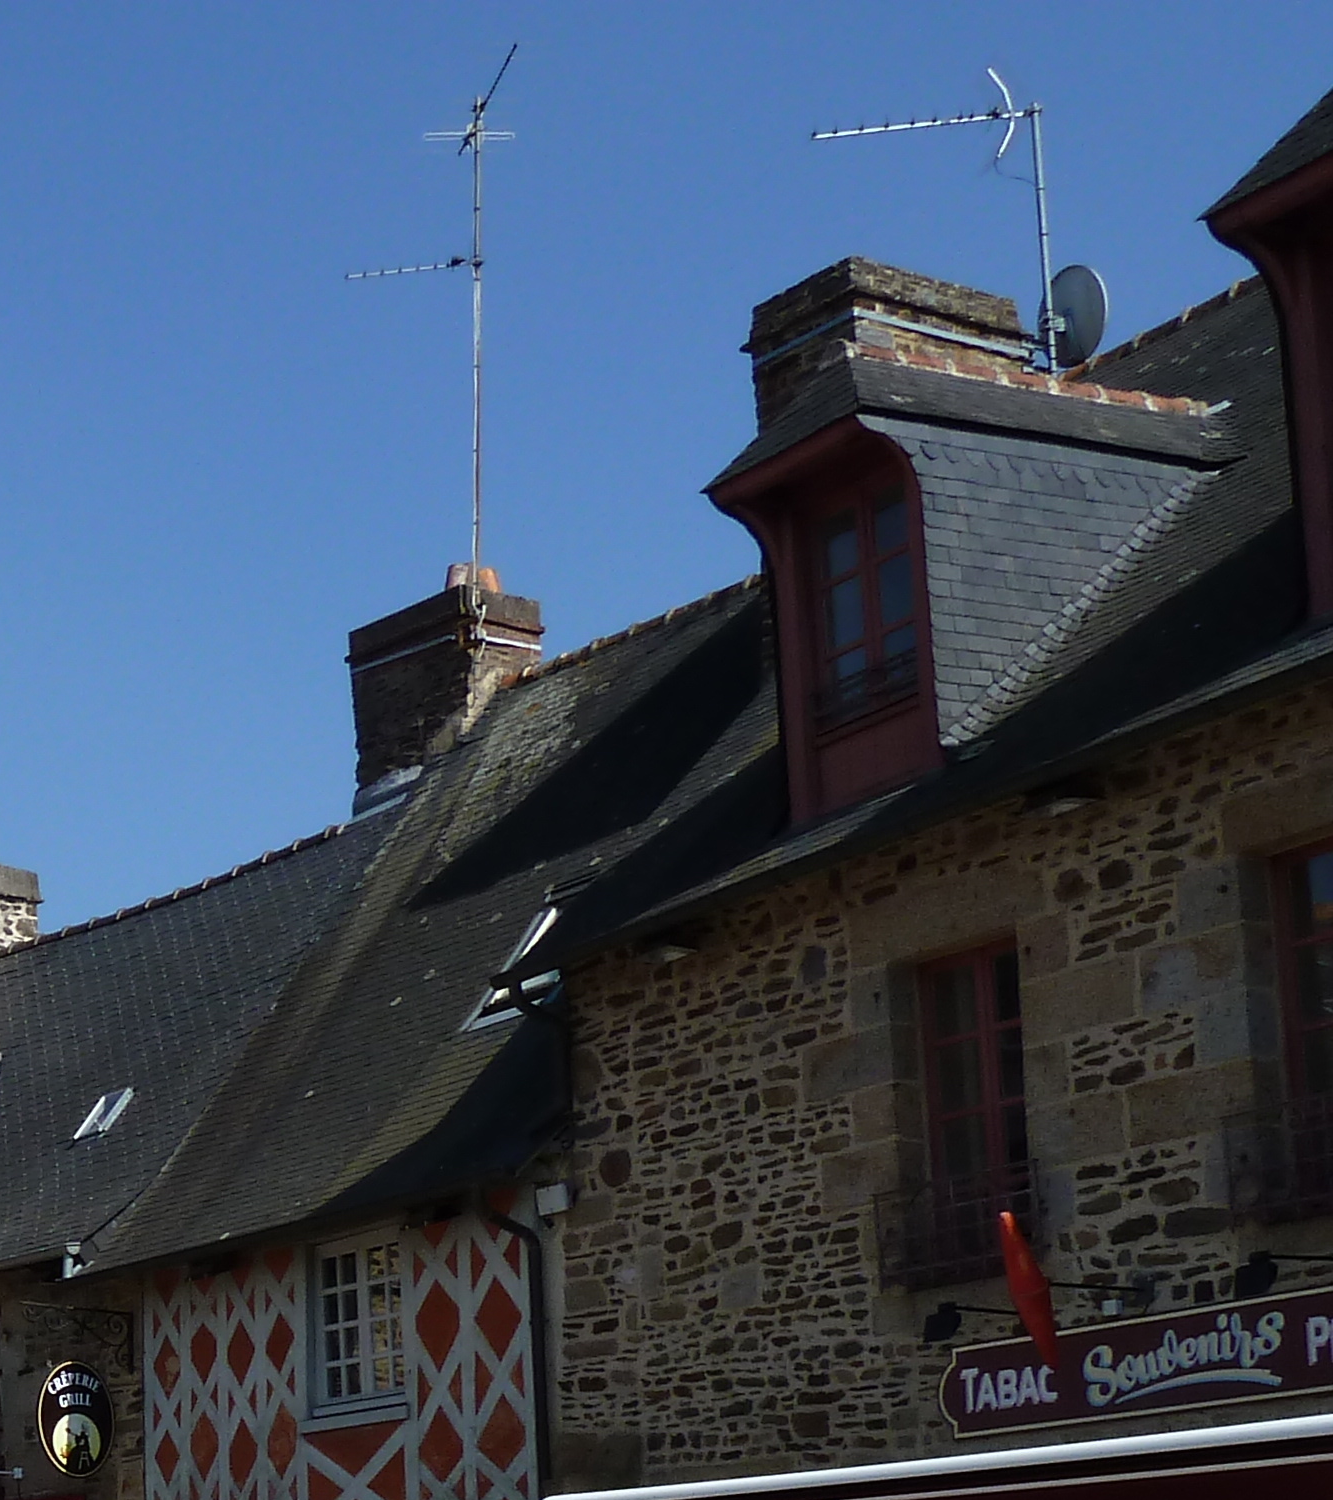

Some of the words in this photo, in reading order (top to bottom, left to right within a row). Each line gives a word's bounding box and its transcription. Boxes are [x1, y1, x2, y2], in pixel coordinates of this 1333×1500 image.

[959, 1364, 1059, 1414] TABAC
[1083, 1311, 1285, 1407] Souvenirs
[59, 1393, 92, 1408] GRILL
